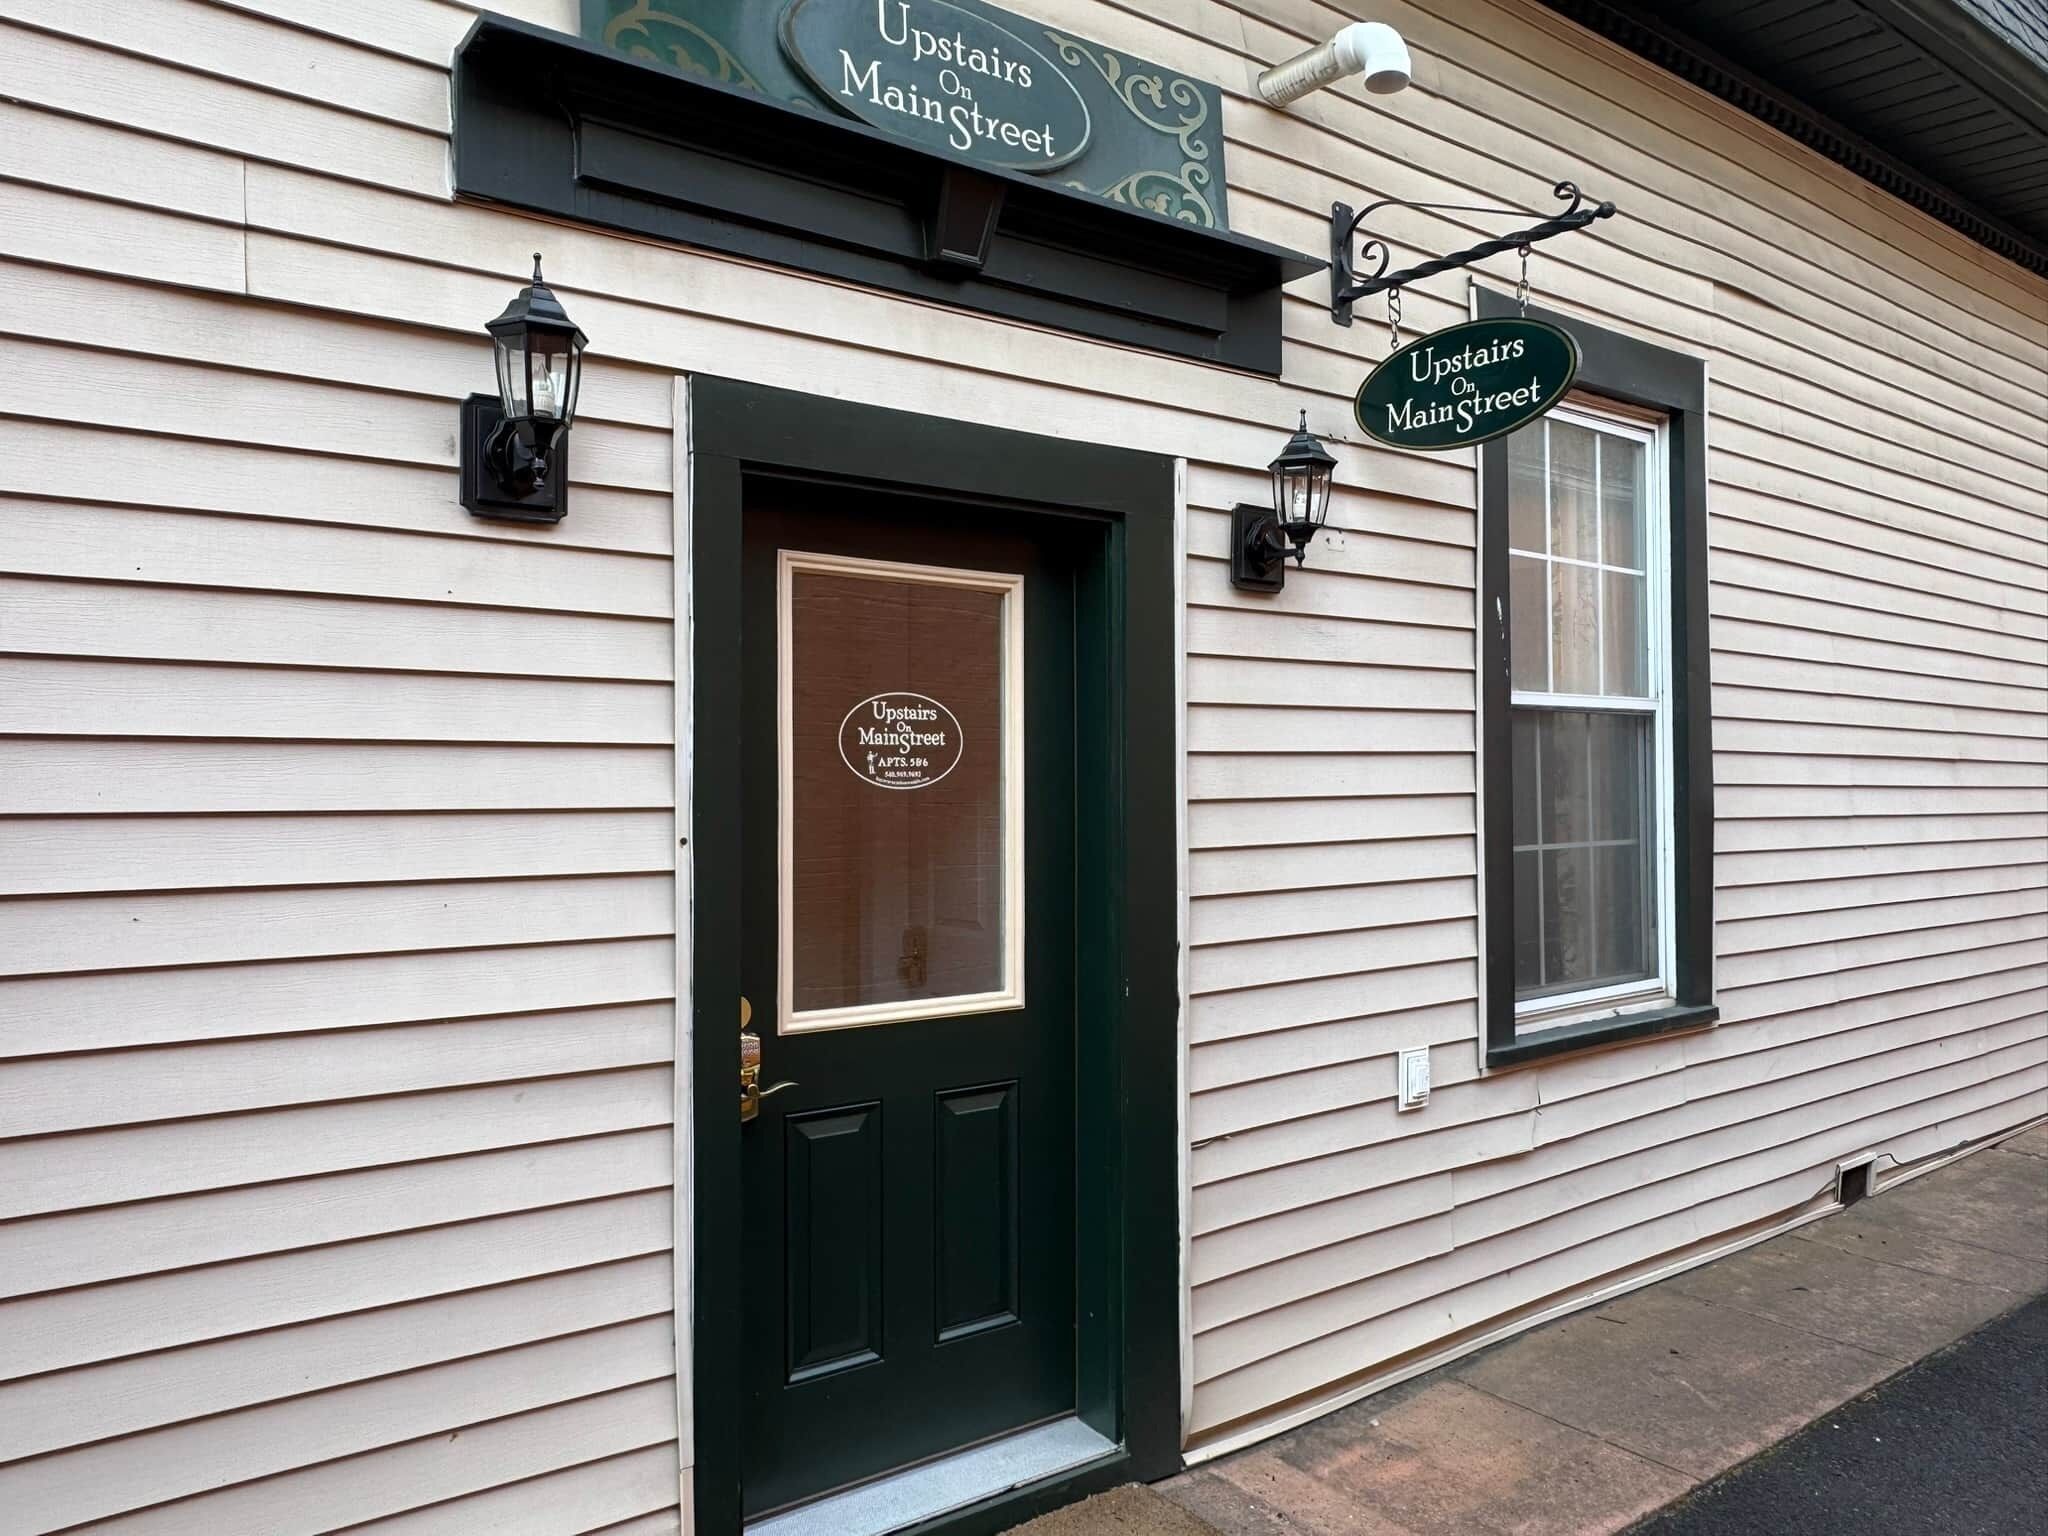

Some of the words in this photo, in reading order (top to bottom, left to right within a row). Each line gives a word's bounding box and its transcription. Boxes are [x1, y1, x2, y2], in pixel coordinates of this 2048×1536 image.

[878, 0, 1033, 88] Upstairs
[938, 69, 973, 101] On
[1410, 338, 1525, 385] Upstairs
[1451, 376, 1476, 396] On
[872, 701, 938, 724] Upstairs
[896, 721, 912, 733] On
[878, 757, 909, 767] APTS.
